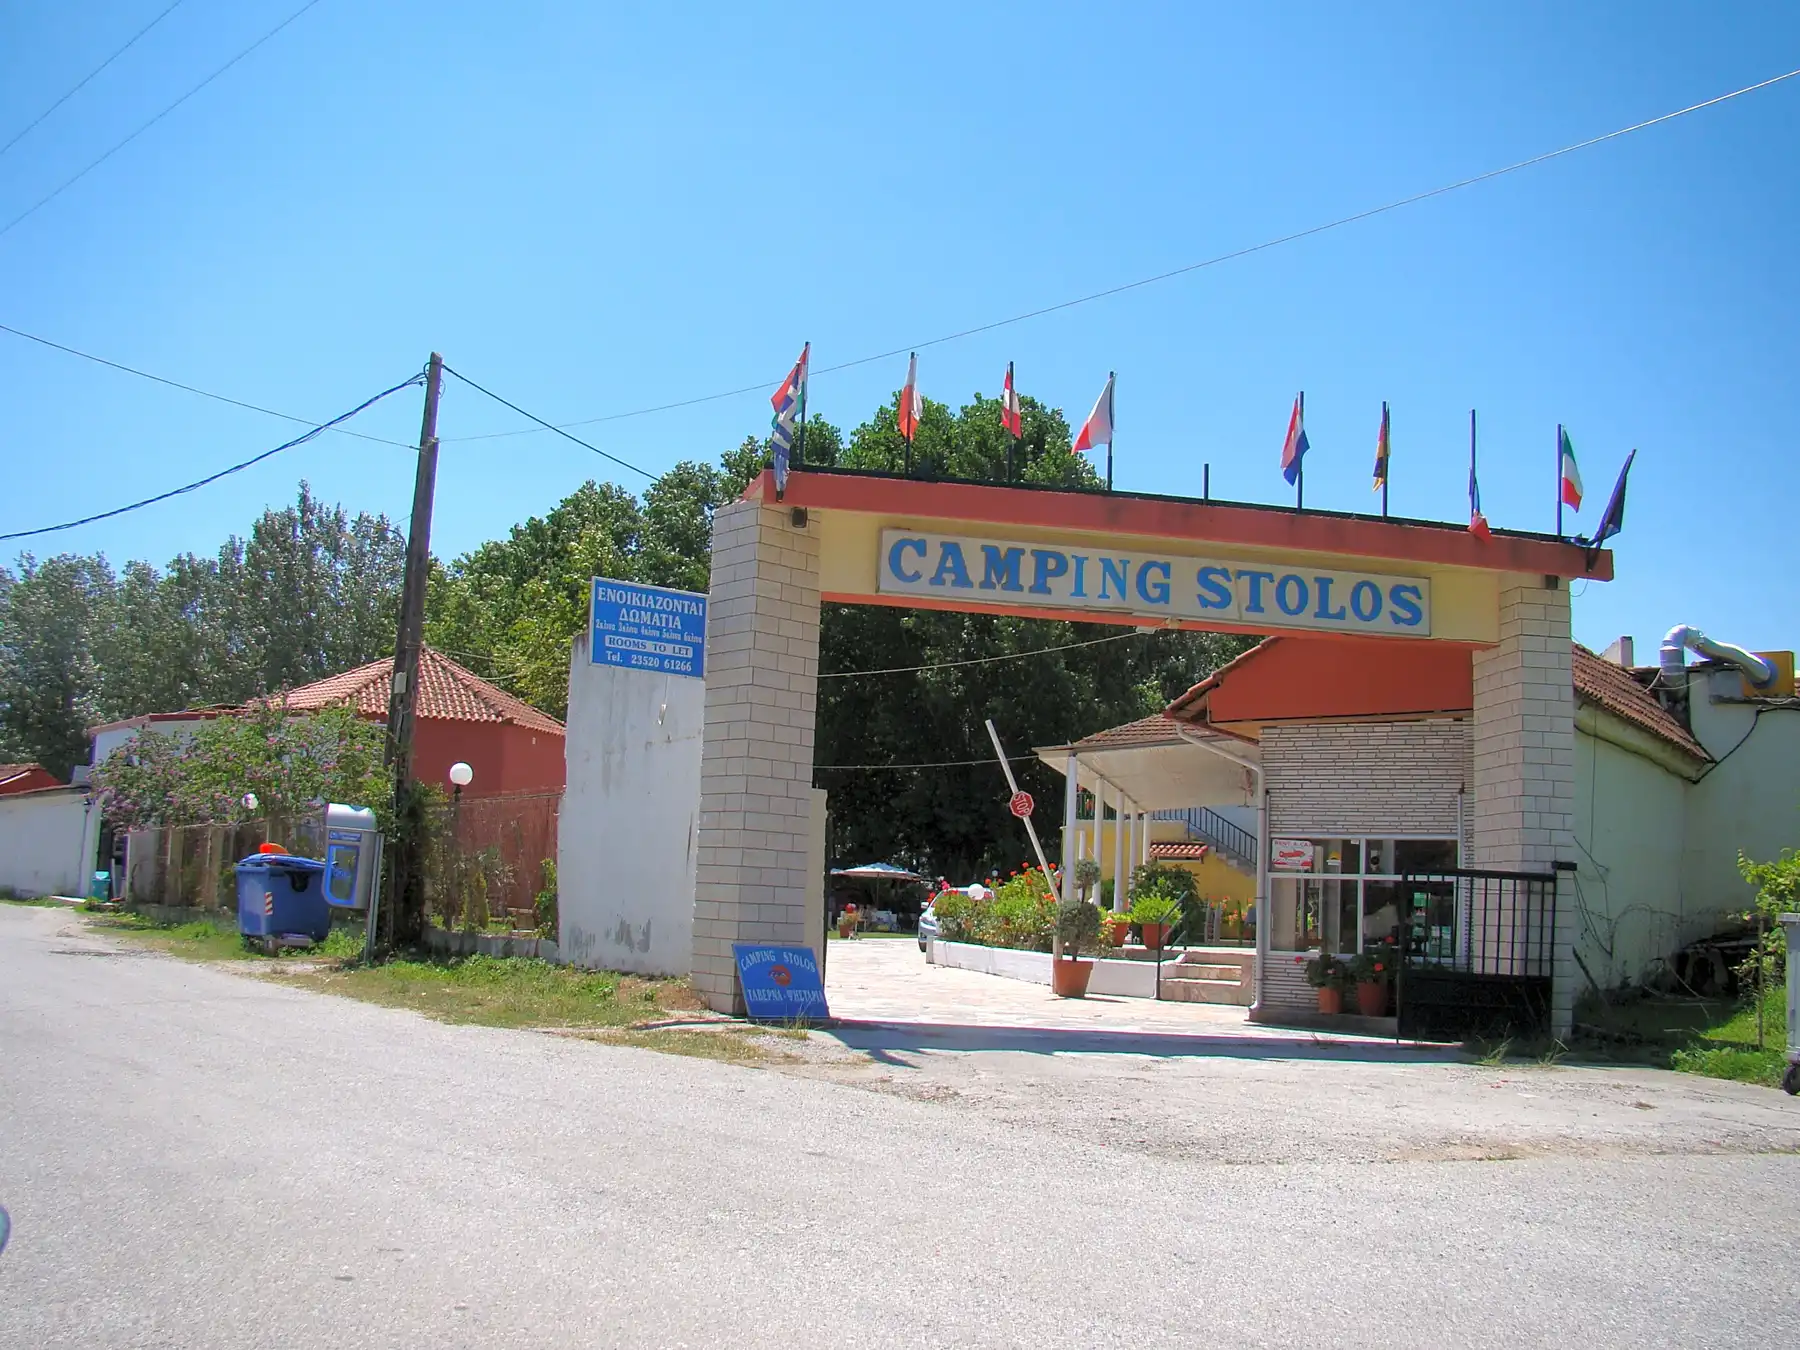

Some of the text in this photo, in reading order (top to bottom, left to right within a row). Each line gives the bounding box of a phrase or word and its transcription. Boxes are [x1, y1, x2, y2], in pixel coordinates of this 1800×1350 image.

[888, 538, 1424, 626] CAMPING STOLOS
[598, 587, 703, 616] ΕΝΟΙΚΙΑΖΟΝΤΑΙ
[619, 608, 682, 629] ΔΩΜΑΤΙΑ
[608, 637, 690, 656] ROOMS TO LET
[606, 651, 692, 671] Tel. 23520 61266
[1014, 793, 1030, 814] STOP
[740, 950, 816, 973] CAMPING STOLOS
